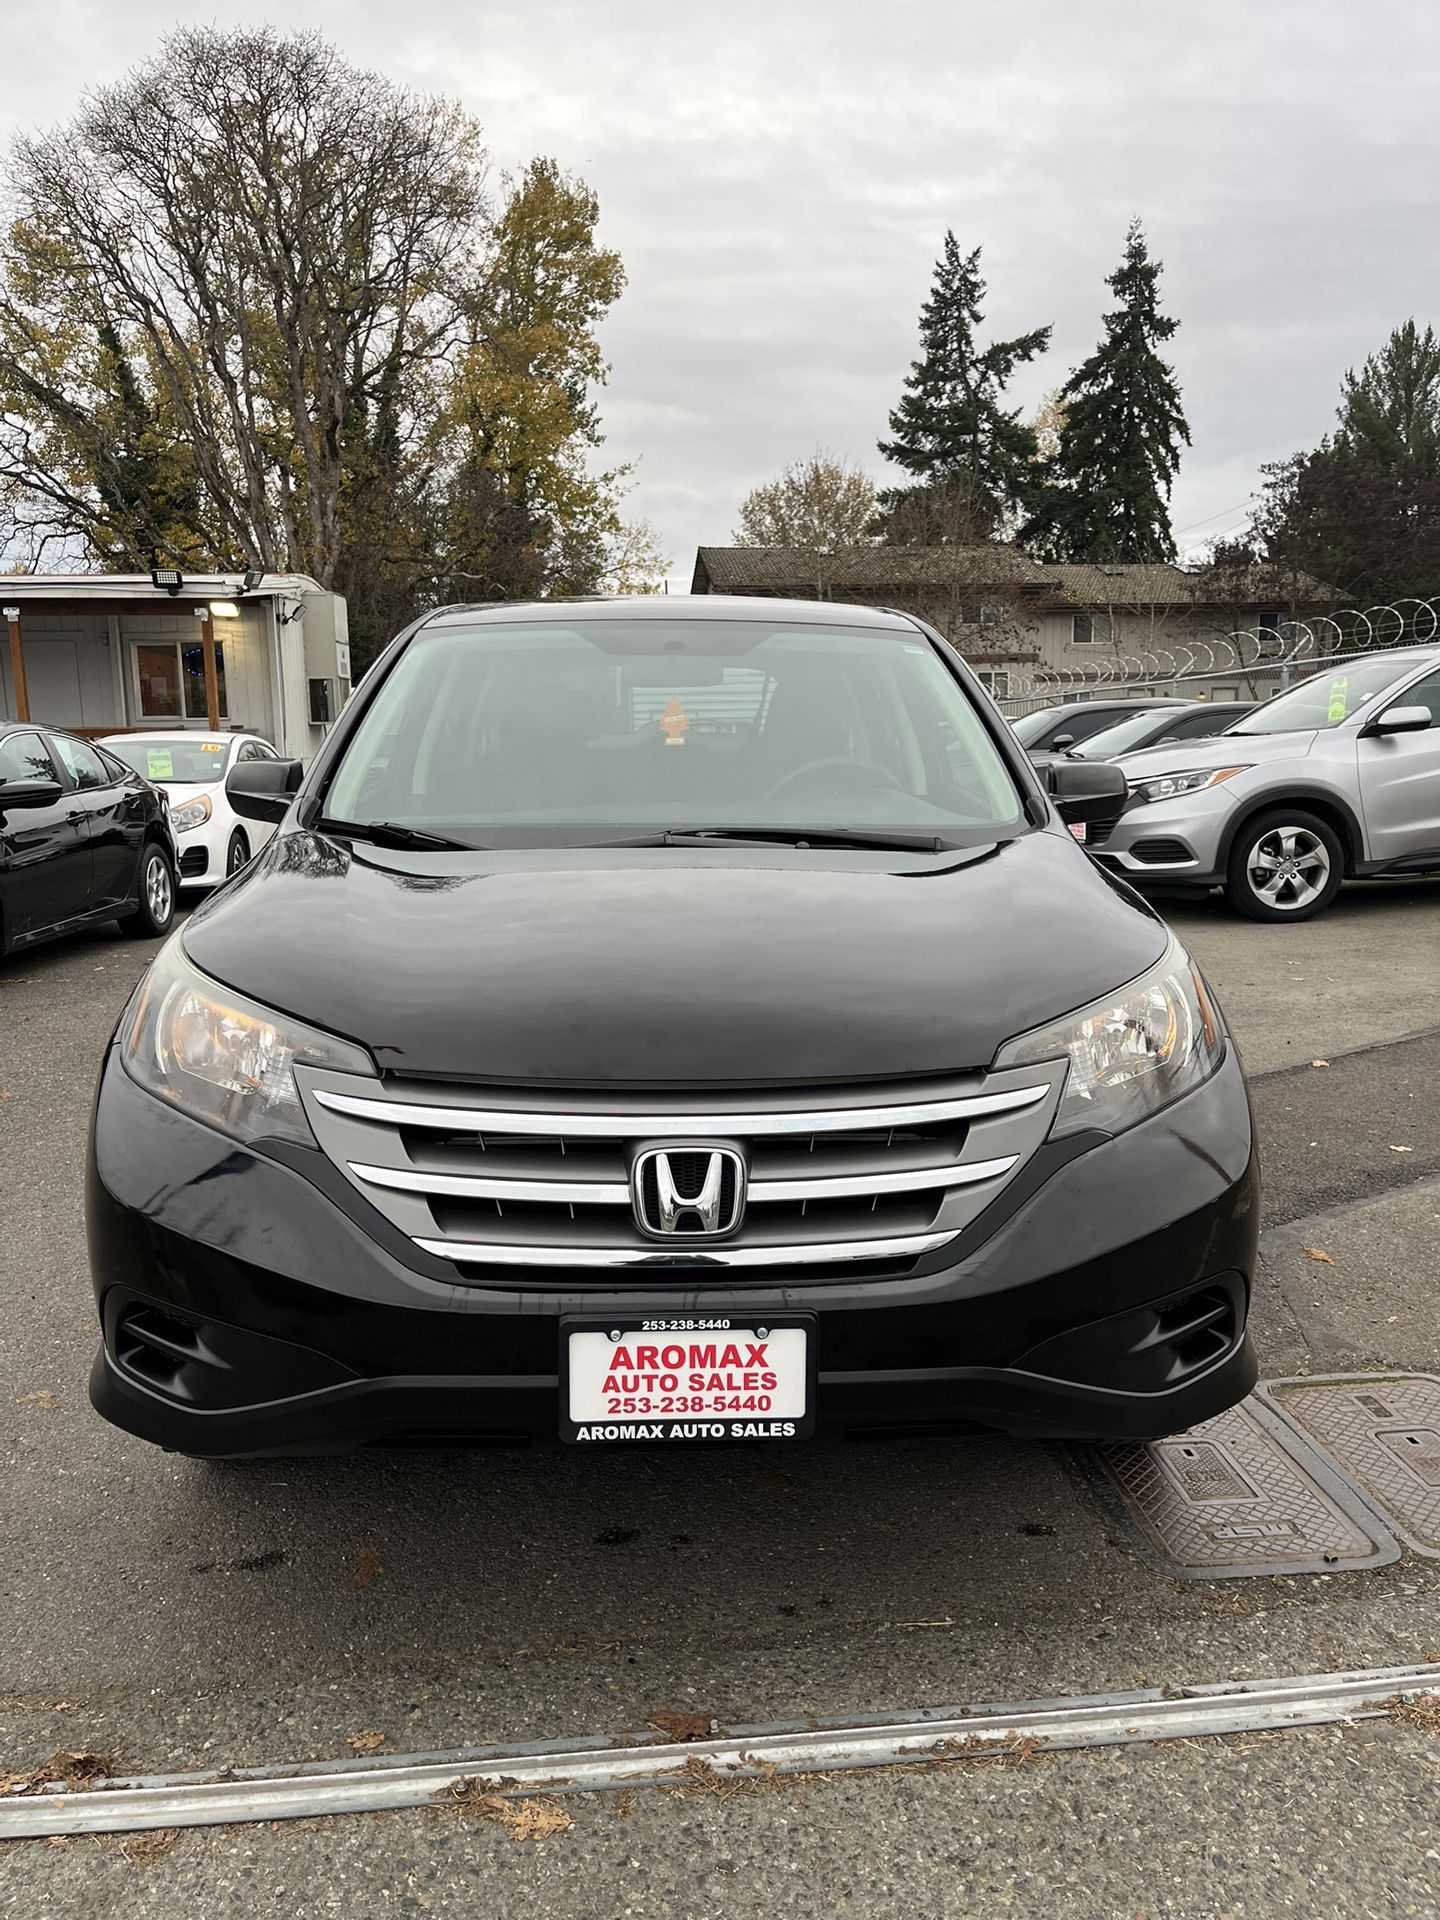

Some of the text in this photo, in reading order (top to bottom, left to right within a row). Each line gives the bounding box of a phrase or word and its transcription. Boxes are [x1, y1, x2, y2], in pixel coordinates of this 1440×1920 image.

[642, 1319, 731, 1331] 253-238-5440
[609, 1343, 769, 1371] AROMAX
[602, 1372, 778, 1393] AUTO SALES
[607, 1395, 772, 1414] 253-238-5440
[576, 1422, 796, 1441] AROMAX AUTO SALES
